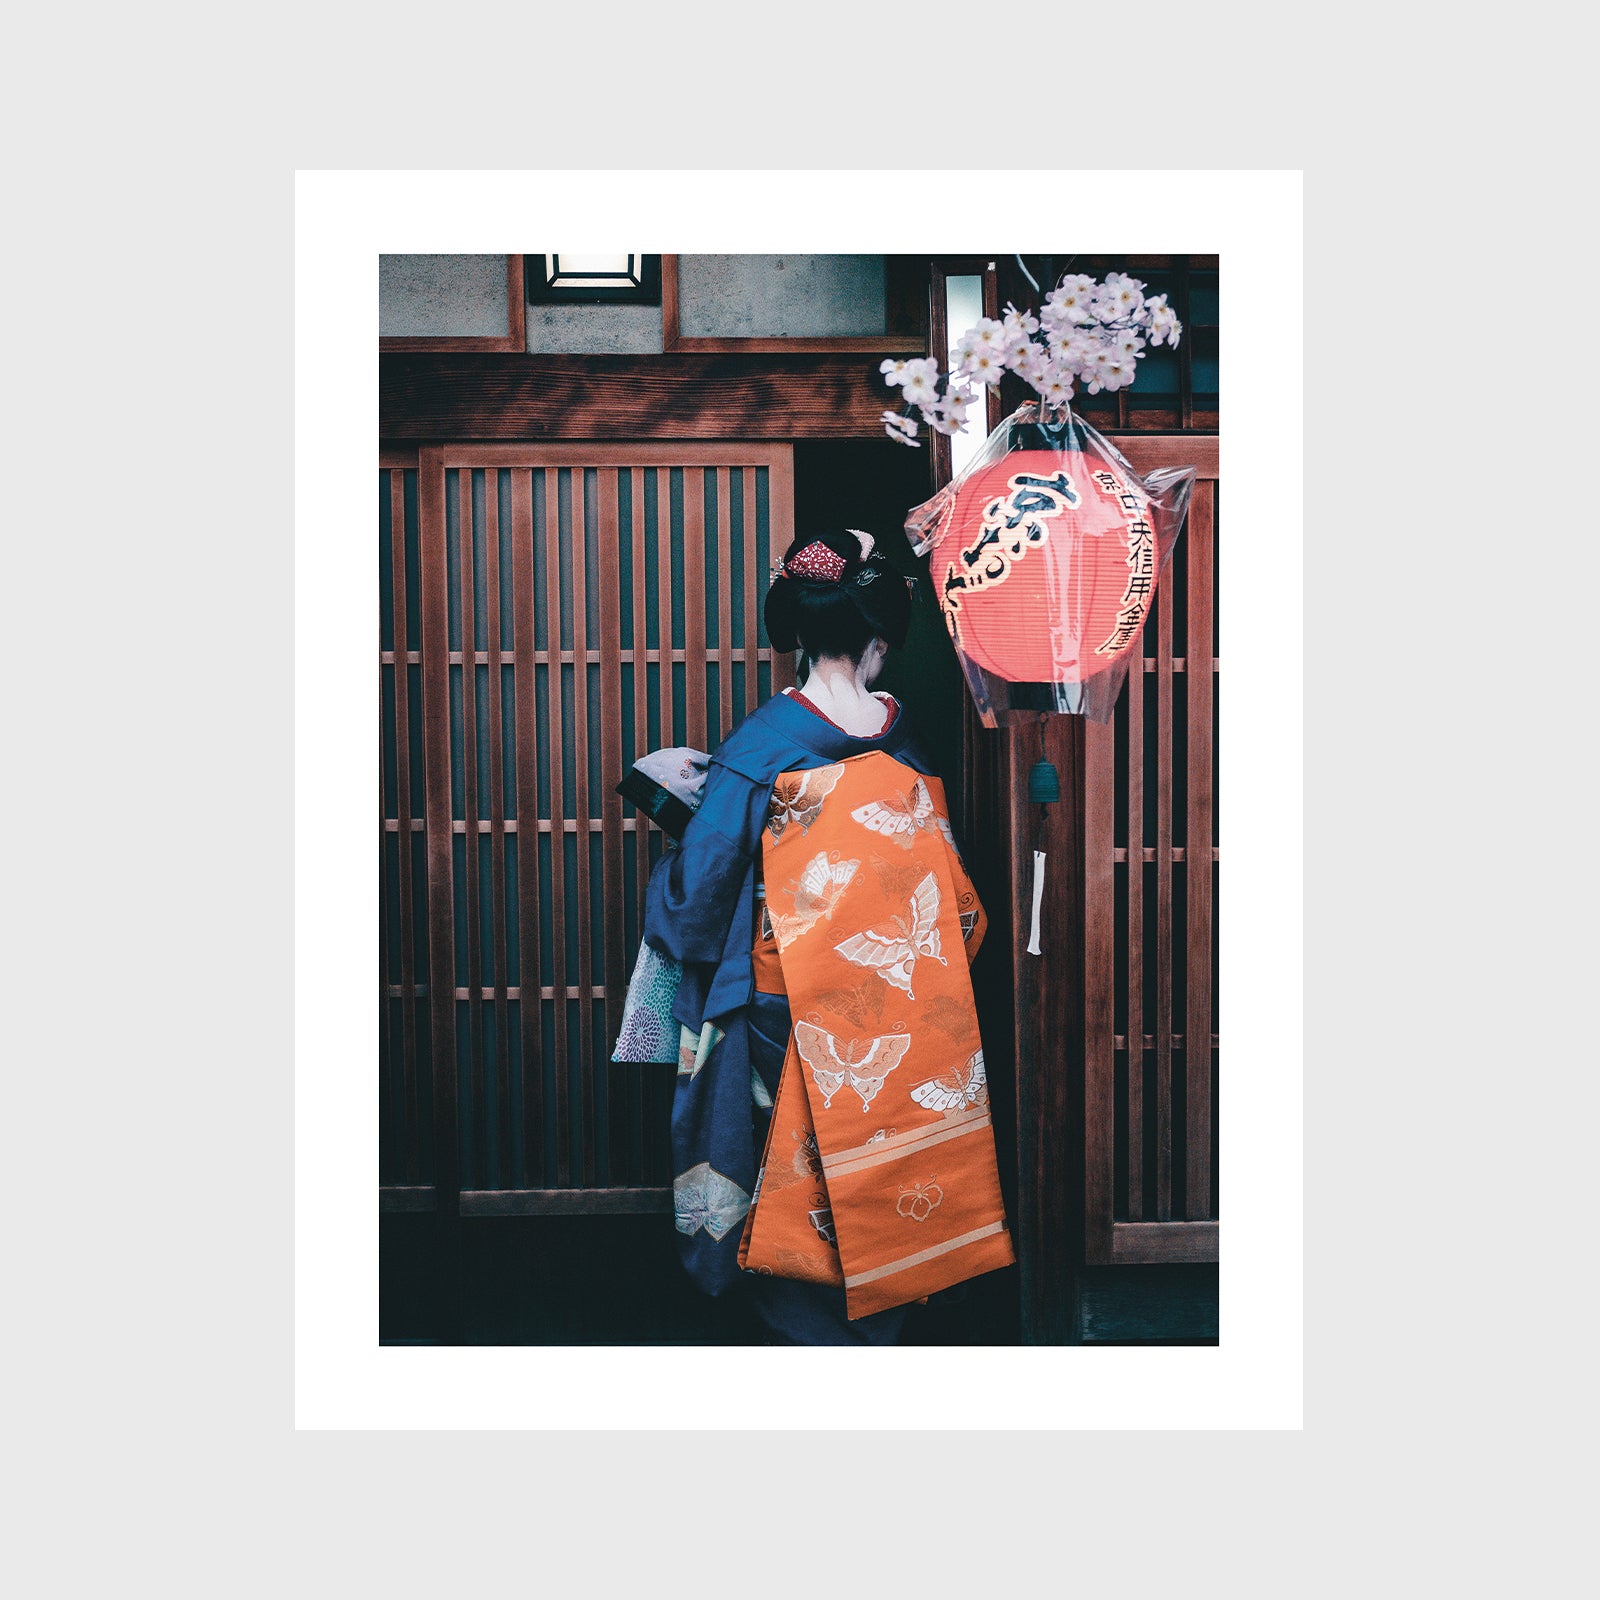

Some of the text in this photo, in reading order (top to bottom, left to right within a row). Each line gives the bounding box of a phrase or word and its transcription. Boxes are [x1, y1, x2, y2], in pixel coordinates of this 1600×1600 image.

[1096, 471, 1153, 653] 京中央信用金庫
